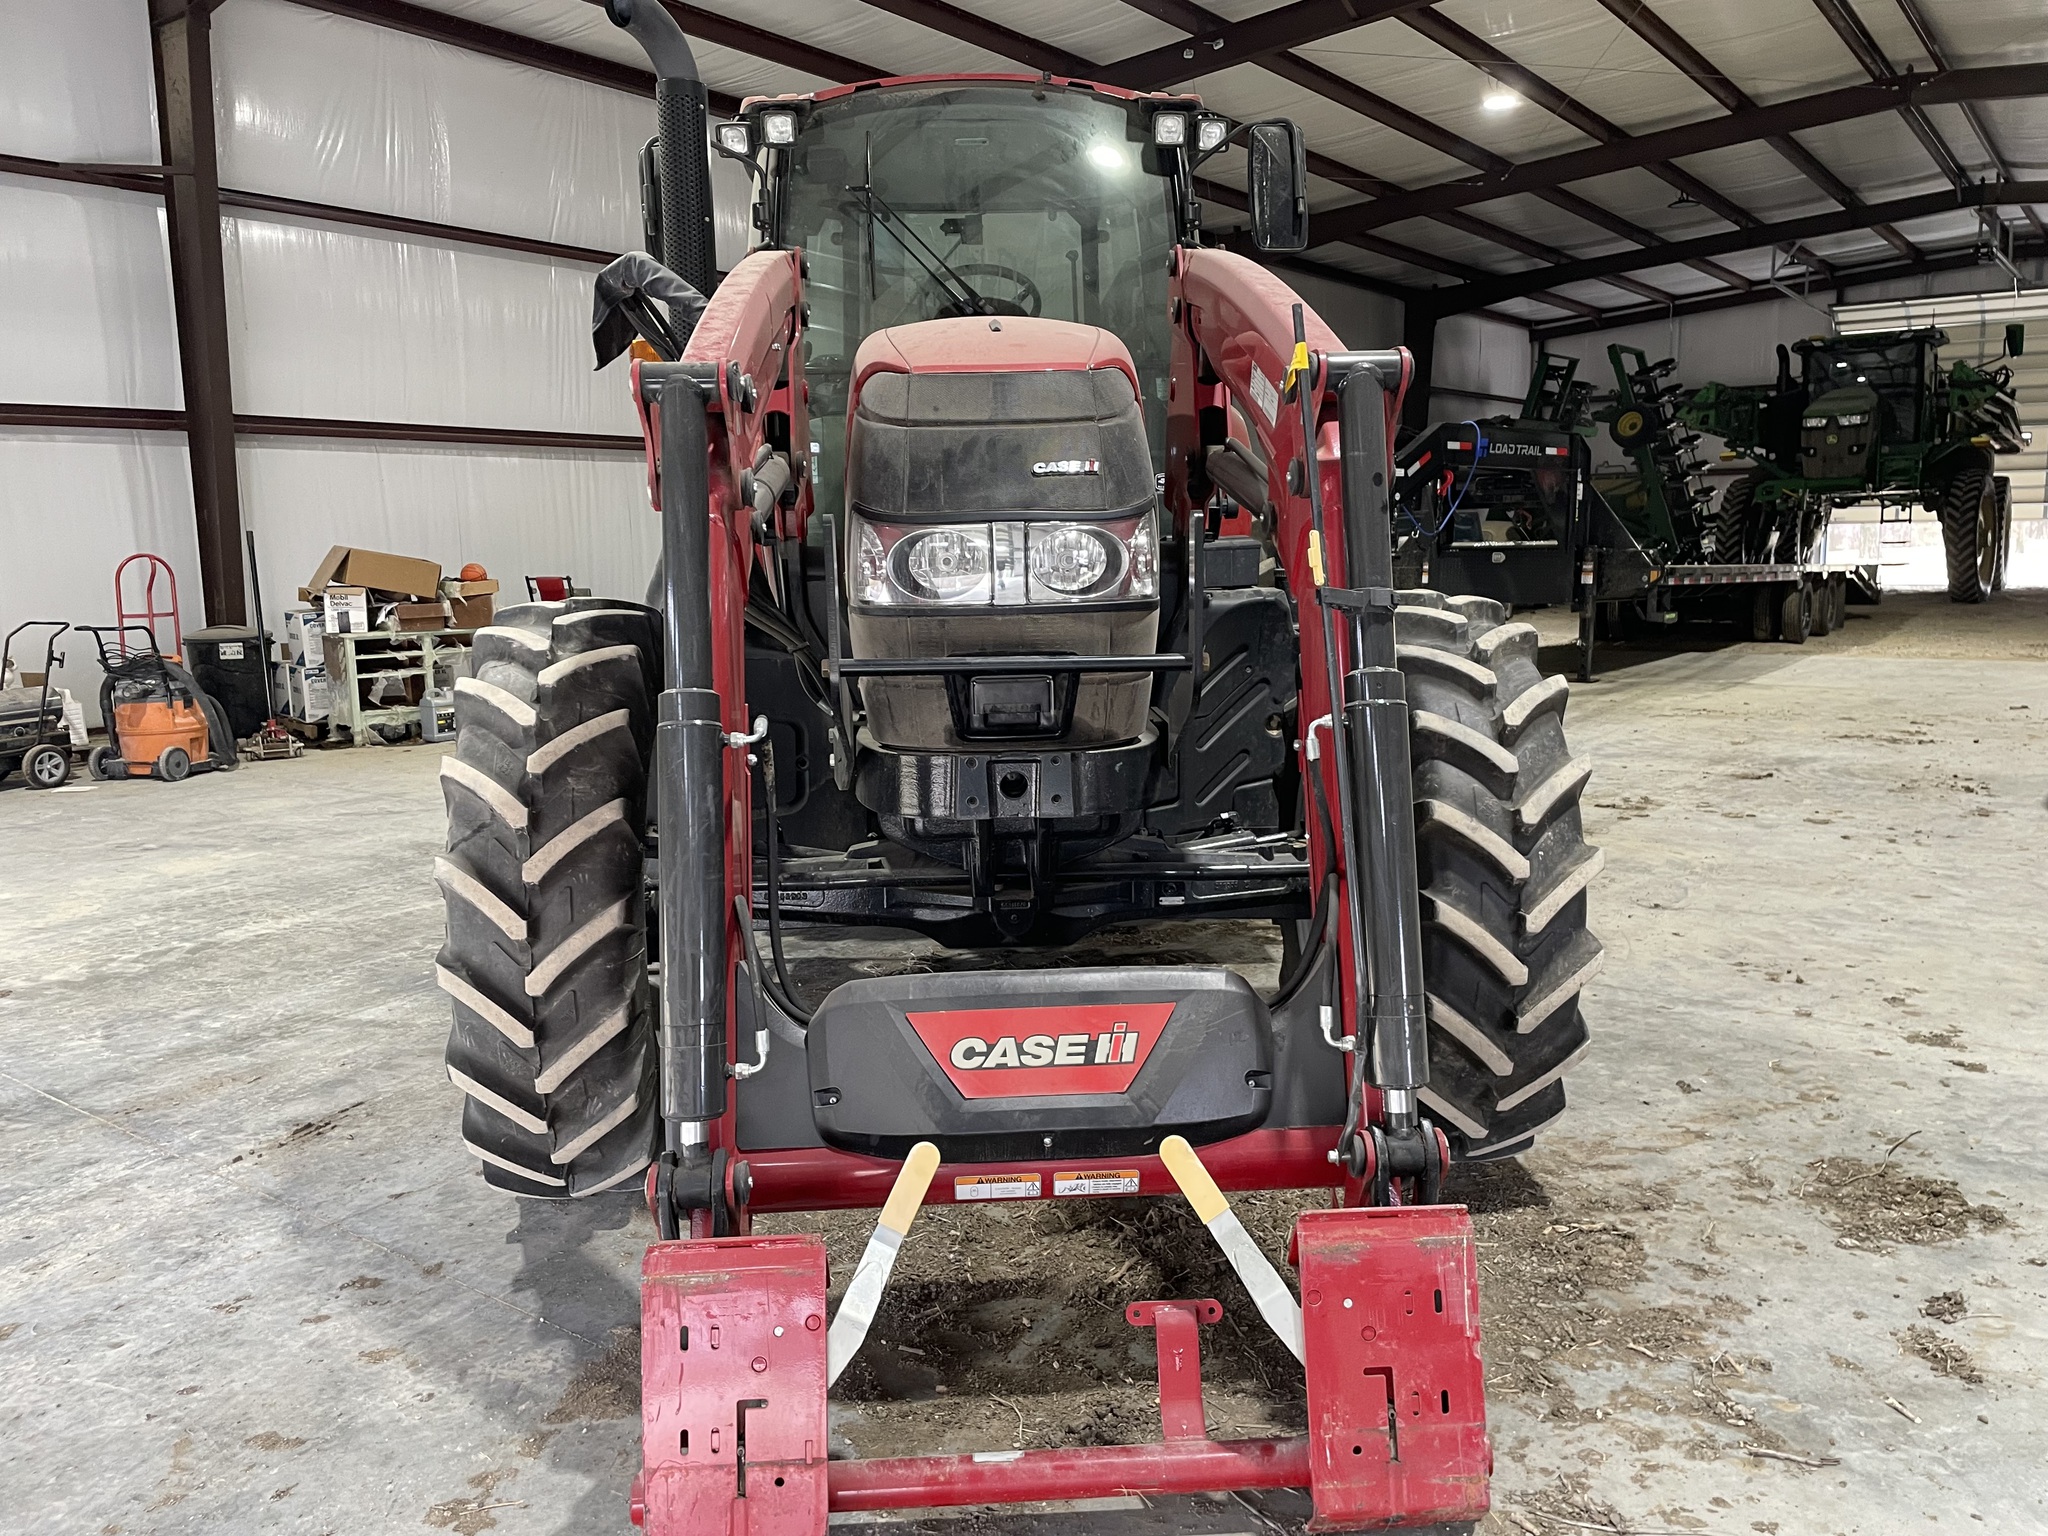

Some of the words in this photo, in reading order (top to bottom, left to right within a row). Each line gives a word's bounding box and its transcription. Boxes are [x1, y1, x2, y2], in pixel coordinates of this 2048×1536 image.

[1489, 443, 1515, 454] LOAD
[1516, 444, 1542, 456] TRAIL
[1033, 460, 1081, 473] CASE
[950, 1034, 1090, 1069] CASE
[984, 1176, 1022, 1184] WARNING
[1083, 1172, 1121, 1180] WARNING
